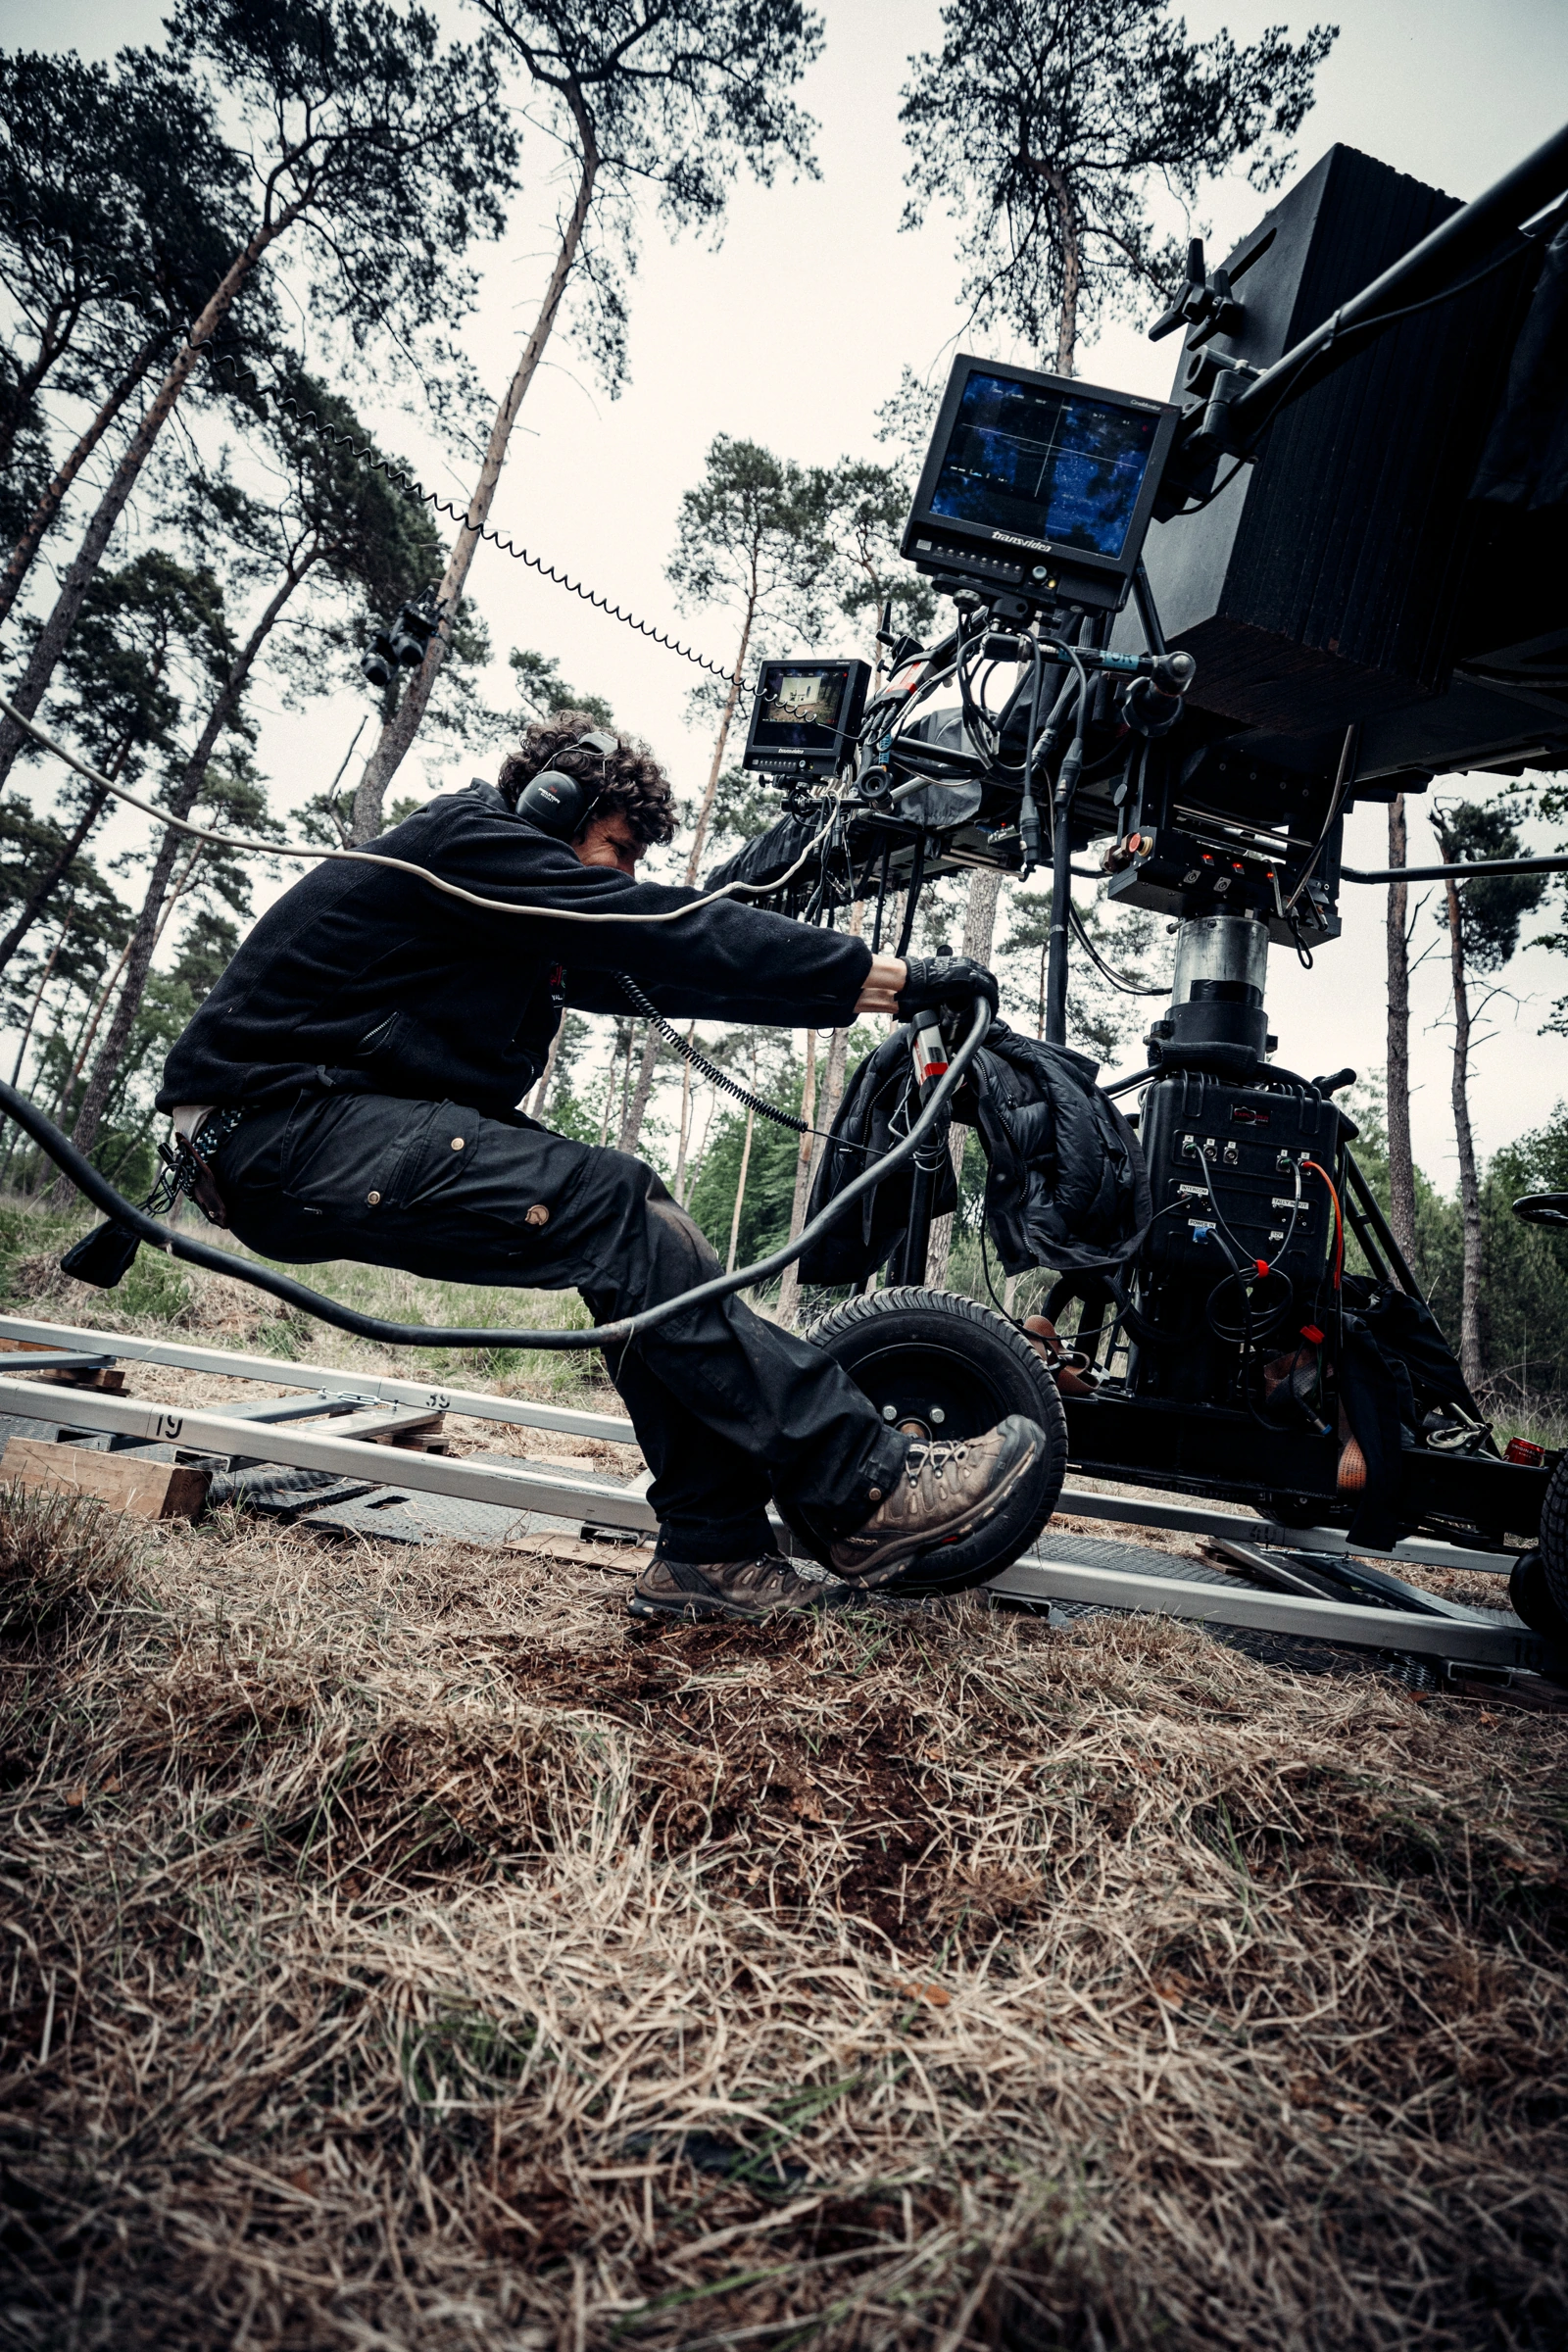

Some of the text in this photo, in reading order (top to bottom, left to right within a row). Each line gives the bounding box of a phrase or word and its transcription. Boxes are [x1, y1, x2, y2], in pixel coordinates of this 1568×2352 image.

[991, 530, 1053, 553] transvideo
[1181, 1185, 1207, 1194] INTERCOM
[425, 1393, 452, 1409] 39
[156, 1414, 183, 1440] 19
[1511, 1444, 1536, 1456] ORIGINAL
